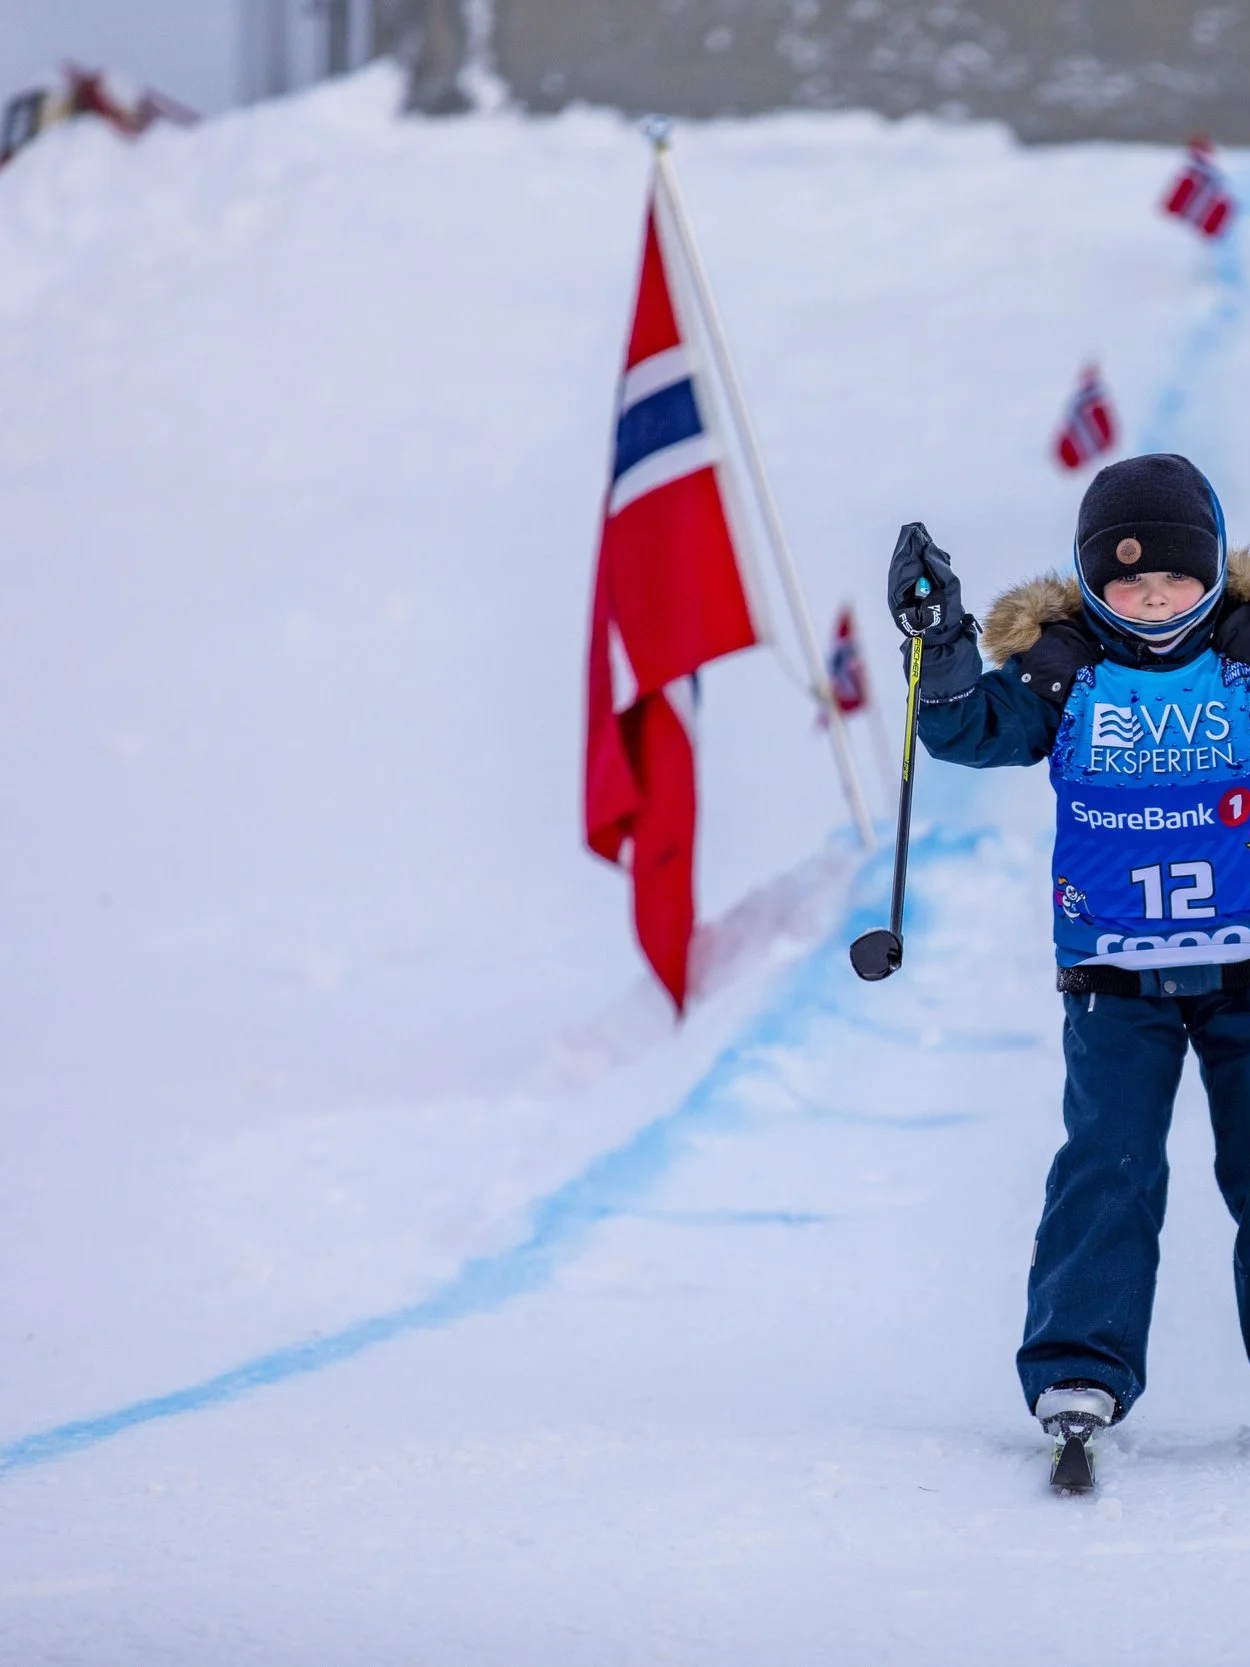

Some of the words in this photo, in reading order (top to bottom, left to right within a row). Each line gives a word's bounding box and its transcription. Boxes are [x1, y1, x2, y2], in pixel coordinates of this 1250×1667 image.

[1139, 701, 1230, 745] VVS
[1090, 744, 1233, 774] EKSPERTEN
[1071, 801, 1215, 830] SpareBank
[1229, 794, 1243, 820] 1
[1130, 860, 1217, 920] 12
